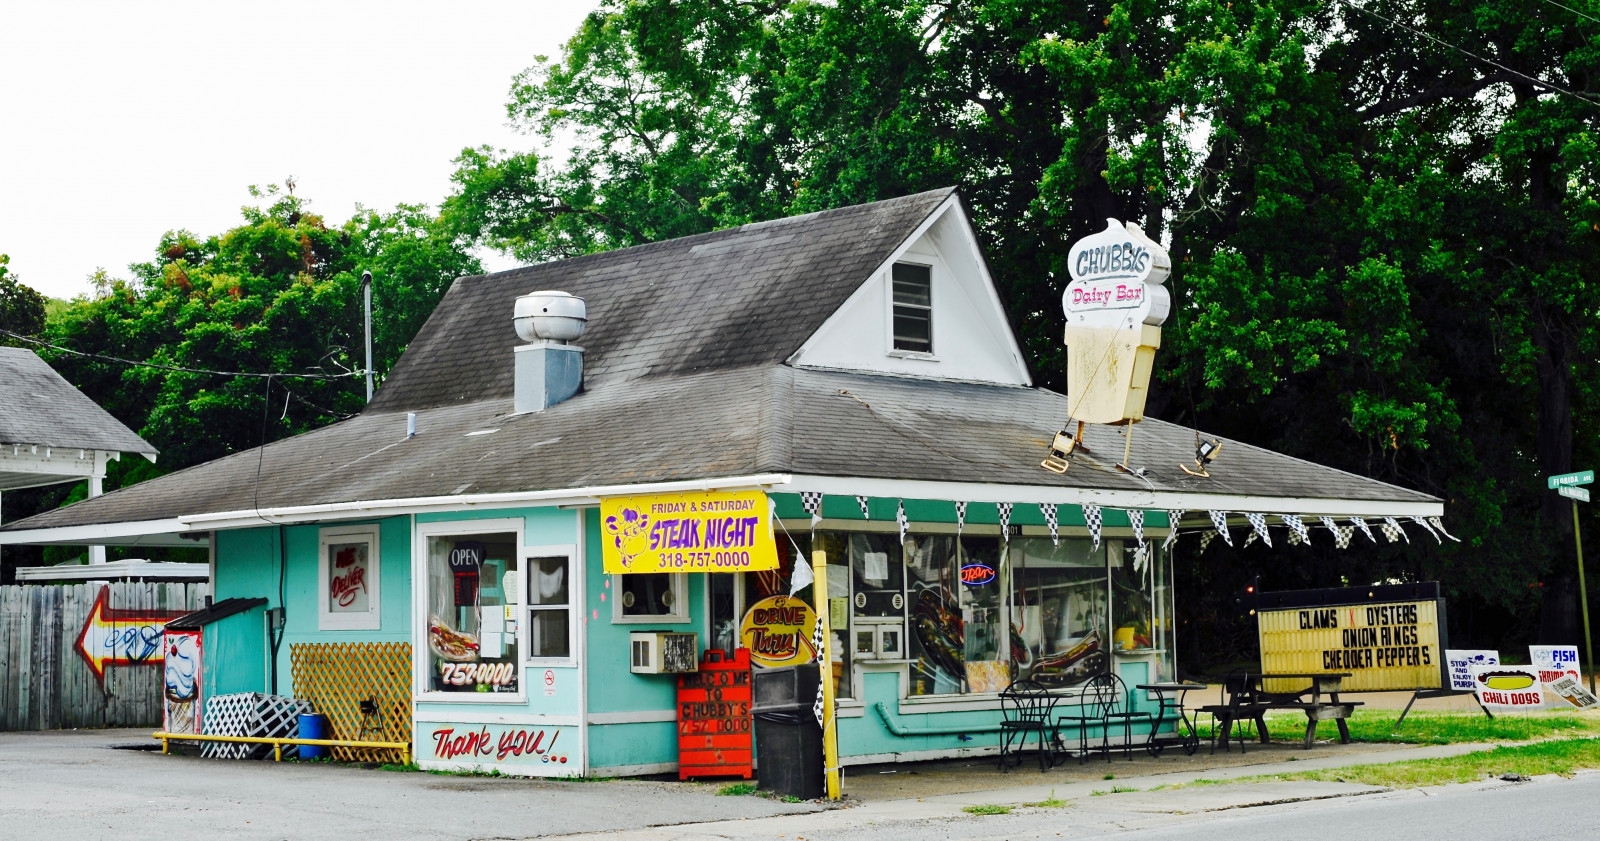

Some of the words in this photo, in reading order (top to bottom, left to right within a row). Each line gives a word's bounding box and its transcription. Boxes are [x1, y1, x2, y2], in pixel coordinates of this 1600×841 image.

[1072, 287, 1111, 305] Dairy
[1117, 285, 1142, 300] Bar
[651, 502, 687, 514] FRIDAY
[690, 502, 698, 512] &
[701, 500, 755, 512] SATURDAY
[649, 518, 701, 551] STEAK
[704, 516, 758, 550] NIGHT
[452, 549, 479, 565] OPEN
[659, 551, 750, 568] 318-757-0000
[753, 607, 806, 625] DRIVE
[1299, 609, 1338, 629] CLAMS
[1366, 605, 1418, 625] OYSTERS
[745, 627, 796, 654] Thru
[1342, 628, 1377, 647] ONION
[1381, 626, 1418, 645] RINGS
[1377, 647, 1430, 666] PEPPERS
[1553, 650, 1577, 662] FISH
[706, 688, 722, 701] TO
[682, 703, 748, 718] CHUBBY'S
[433, 725, 494, 759] Thank
